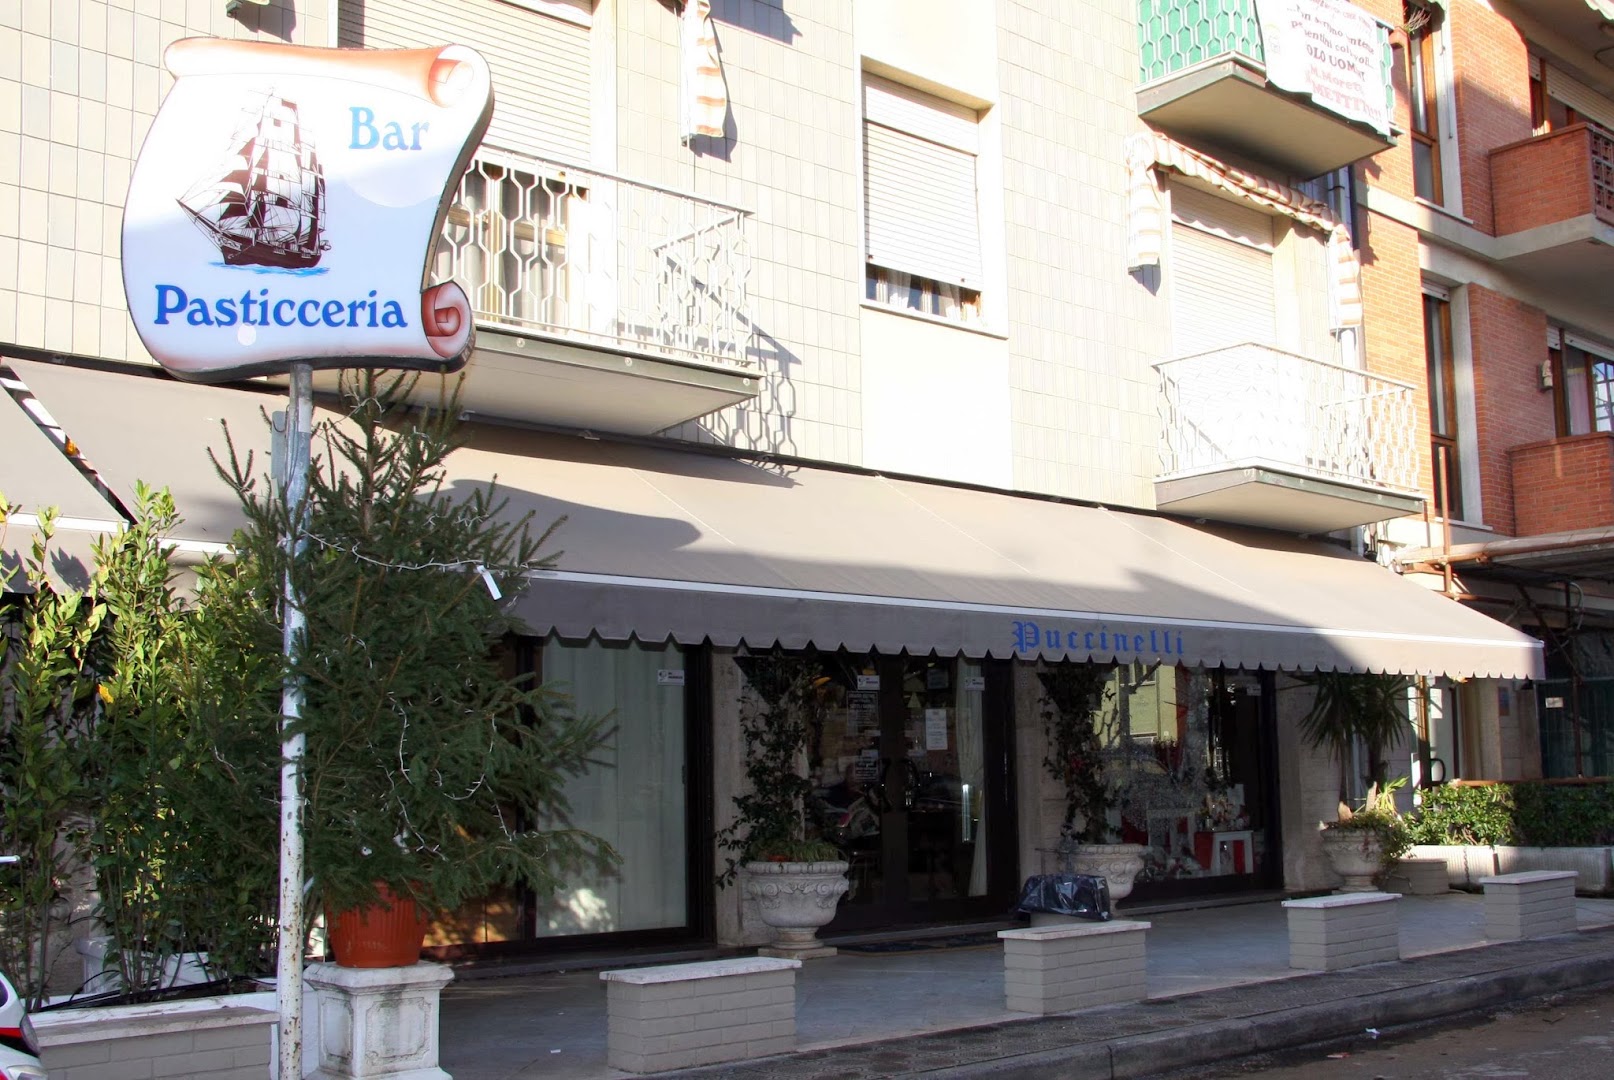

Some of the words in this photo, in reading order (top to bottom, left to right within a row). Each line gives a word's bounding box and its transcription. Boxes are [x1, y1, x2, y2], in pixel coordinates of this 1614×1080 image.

[348, 106, 430, 151] Bar
[153, 284, 409, 329] Pasticceria
[1010, 620, 1185, 655] Puccinelli
